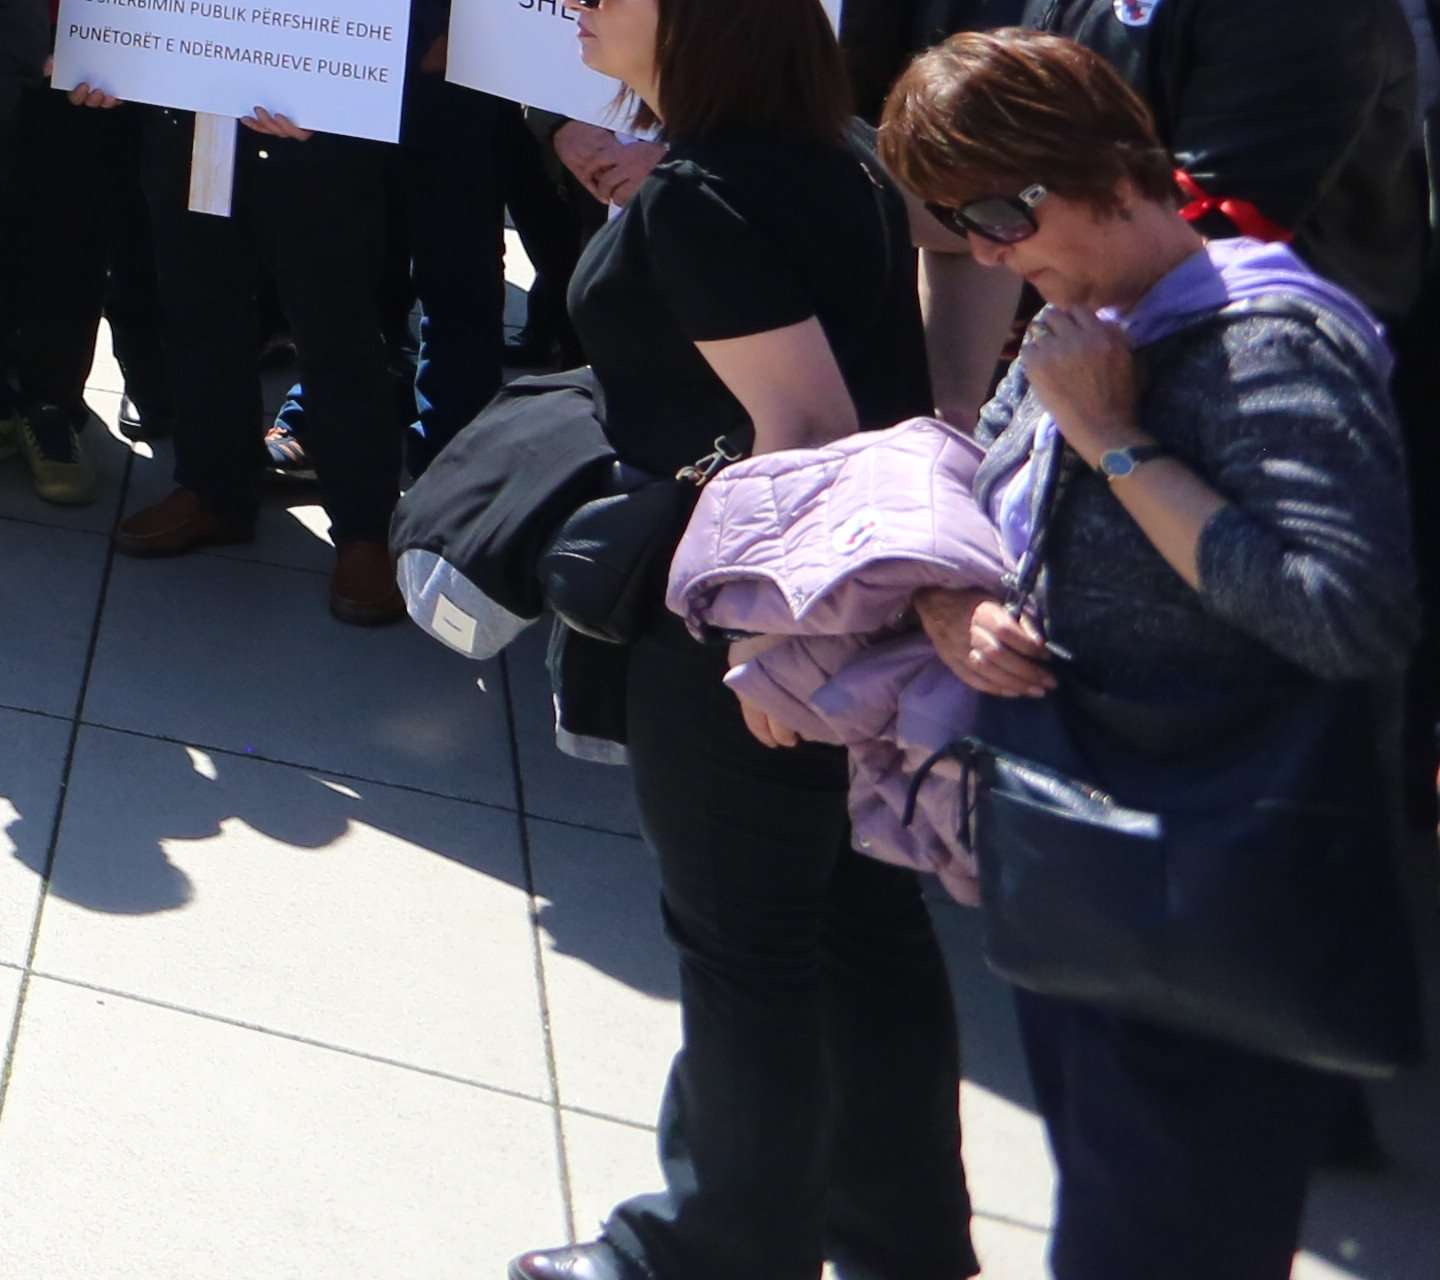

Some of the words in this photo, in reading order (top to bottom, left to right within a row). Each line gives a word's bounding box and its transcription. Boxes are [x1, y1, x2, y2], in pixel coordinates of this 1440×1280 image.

[190, 1, 247, 23] PUBLIK
[251, 7, 340, 35] PËRFSHIRË
[346, 21, 393, 42] EDHE
[69, 23, 161, 51] PUNËTORËT
[165, 38, 175, 53] E
[179, 39, 312, 73] NDËRMARRJEVE
[317, 59, 389, 83] PUBLIKE
